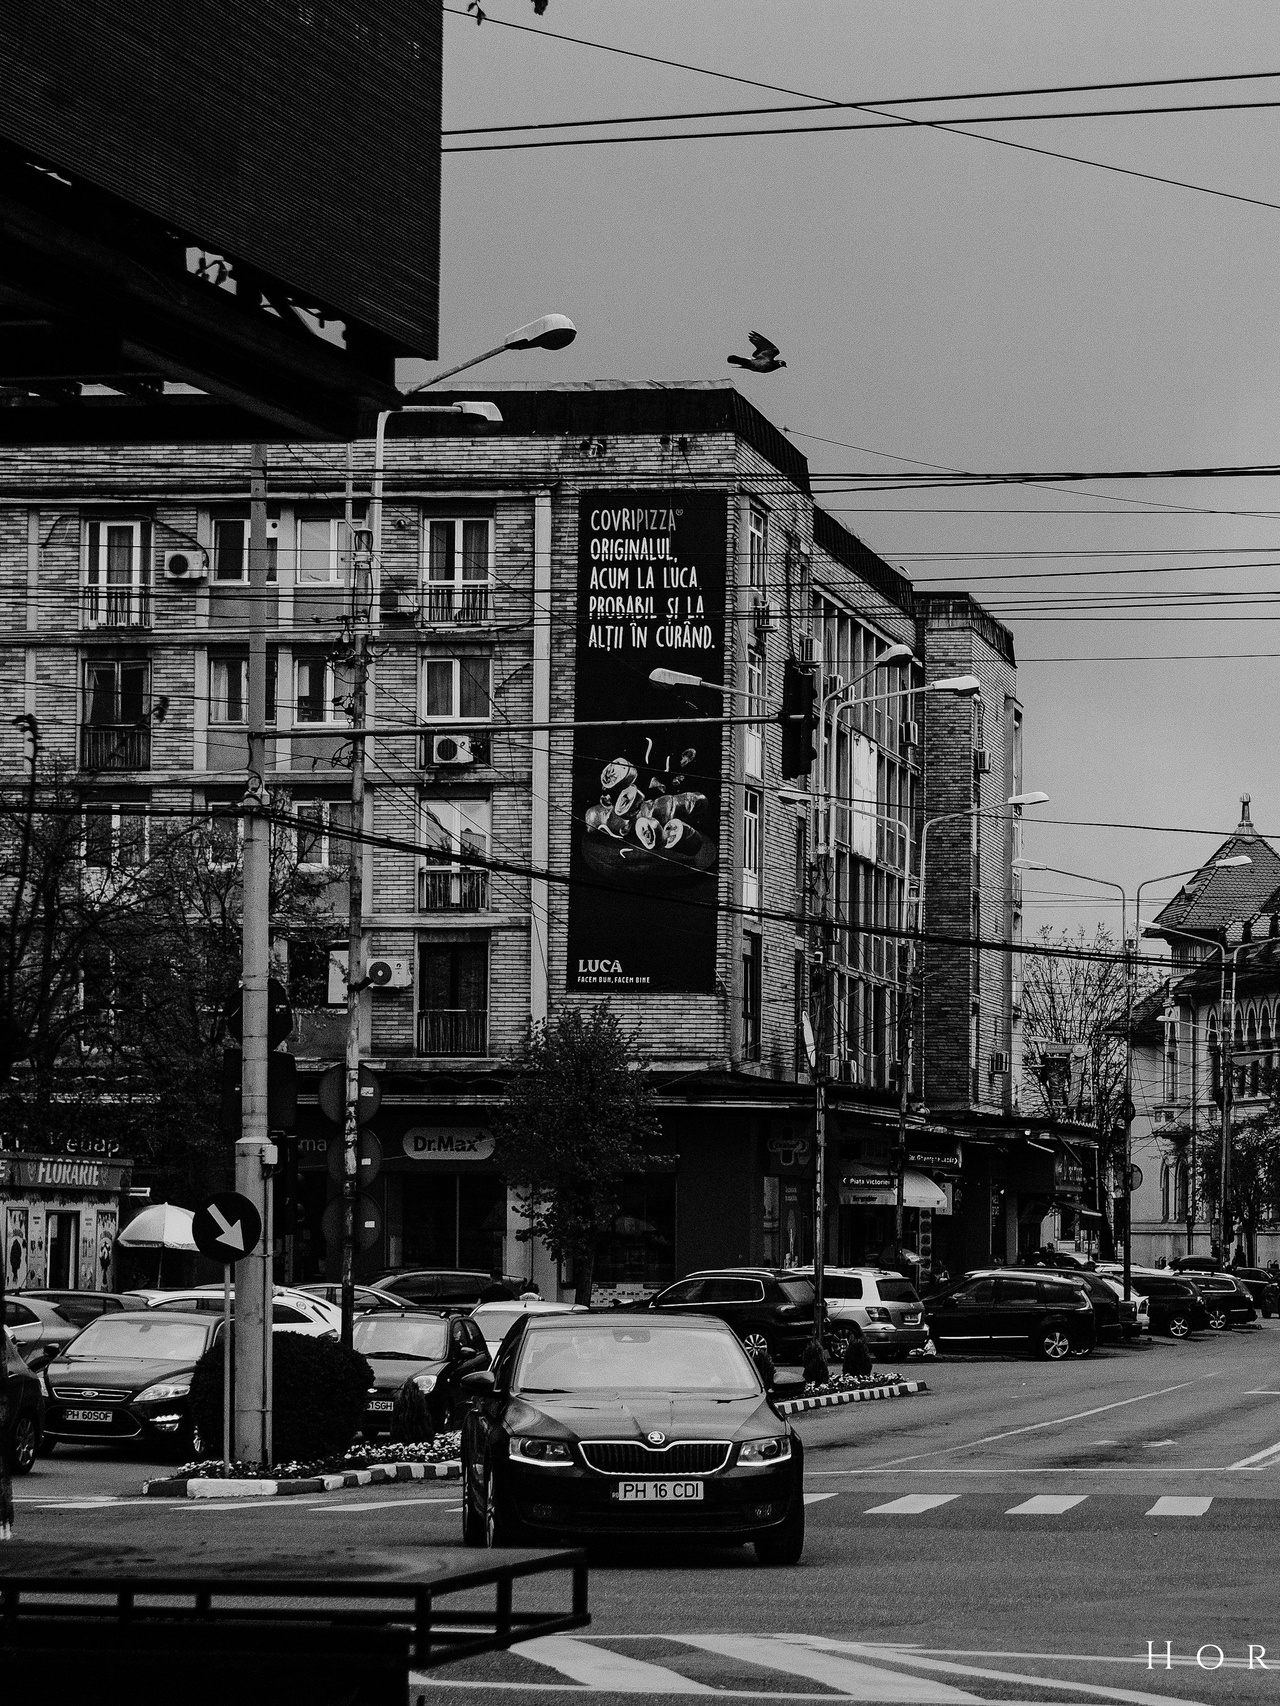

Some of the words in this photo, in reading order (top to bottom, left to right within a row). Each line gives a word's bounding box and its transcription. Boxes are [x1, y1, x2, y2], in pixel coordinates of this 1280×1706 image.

[590, 537, 678, 563] ORIGINALUL,
[590, 566, 629, 589] ACUM
[637, 566, 655, 589] LA
[589, 595, 658, 619] PROBABIL
[687, 595, 705, 619] LA
[630, 622, 648, 648] ÎN
[655, 621, 716, 650] CURÂND.
[578, 959, 623, 973] LUCA
[614, 976, 634, 984] FACEM
[37, 1157, 103, 1187] FLORARIE
[66, 1410, 80, 1419] PH
[624, 1483, 646, 1498] PH
[653, 1483, 668, 1498] 16
[673, 1483, 699, 1498] CDI
